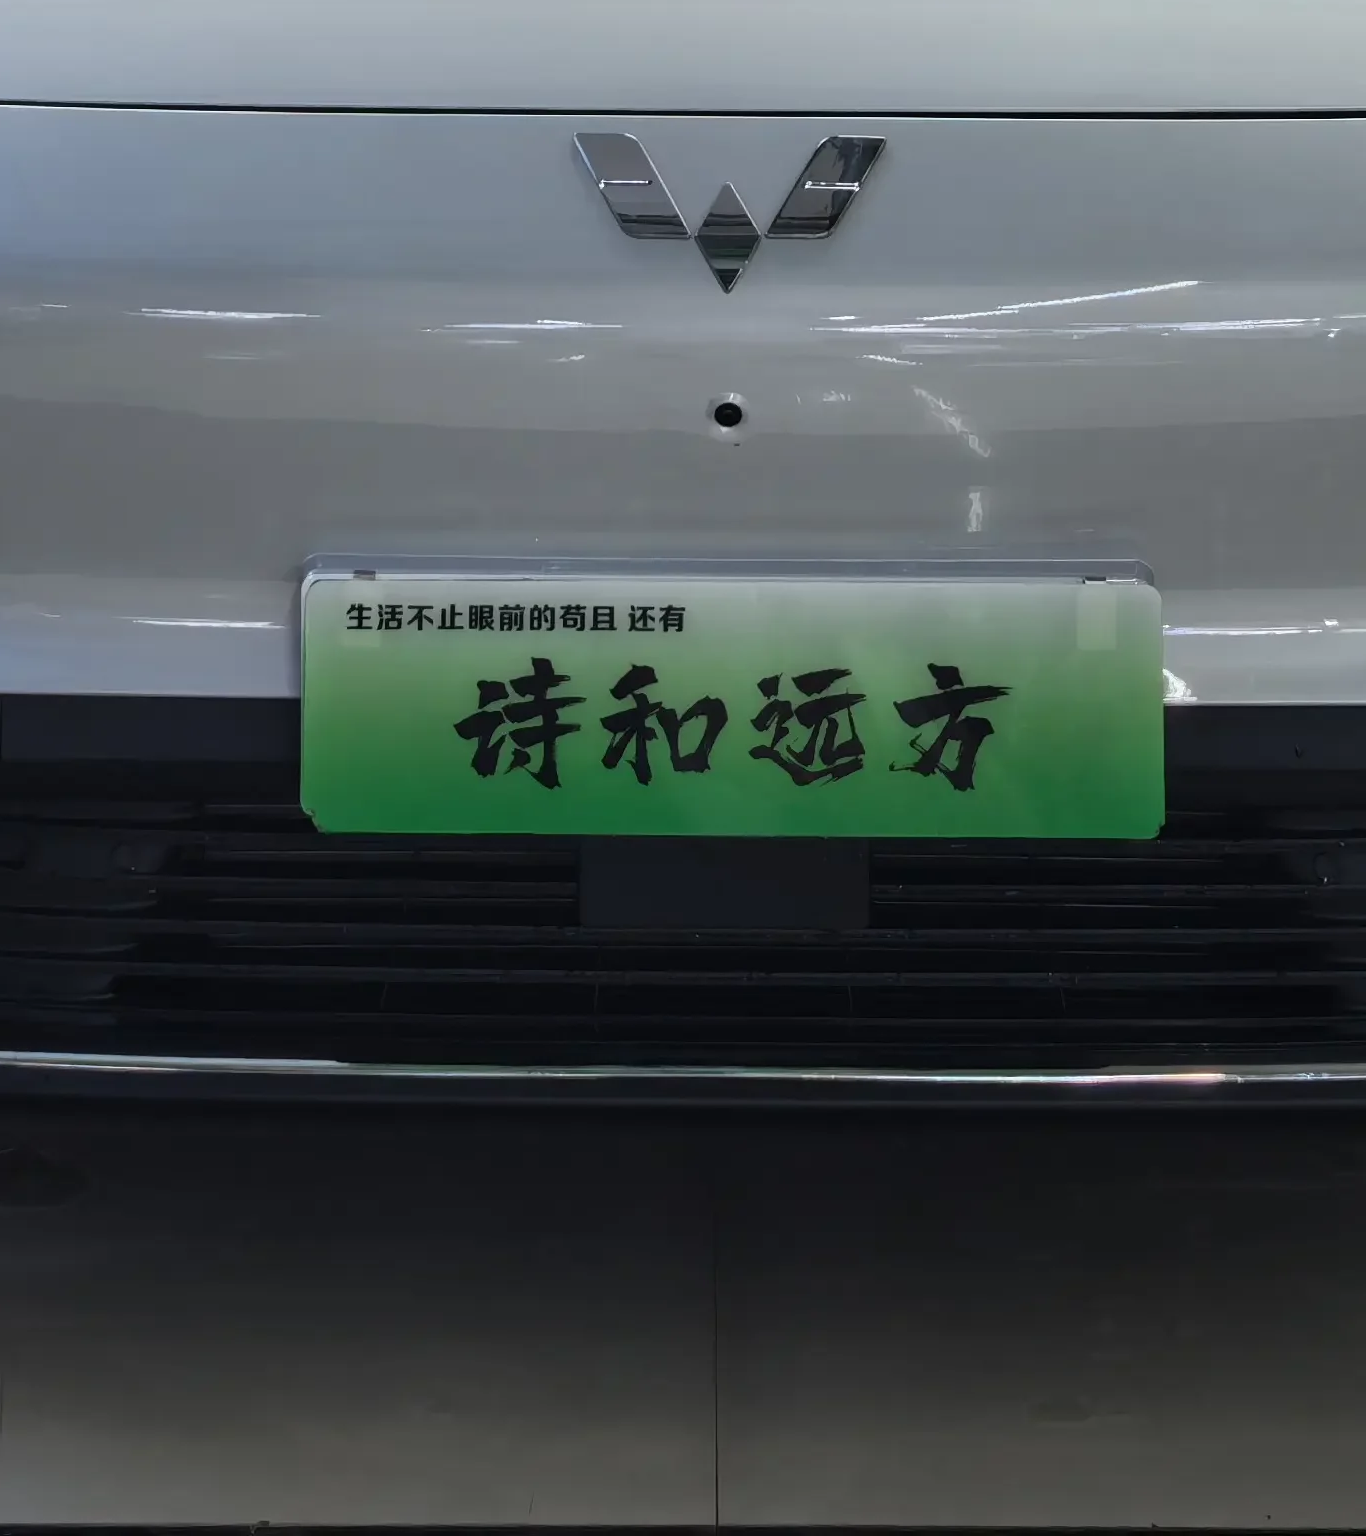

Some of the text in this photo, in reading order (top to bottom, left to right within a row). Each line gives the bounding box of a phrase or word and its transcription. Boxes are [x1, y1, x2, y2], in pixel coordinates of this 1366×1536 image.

[345, 604, 687, 633] 生活不止眼前的苟且 还有
[453, 656, 1015, 792] 诗和远方
